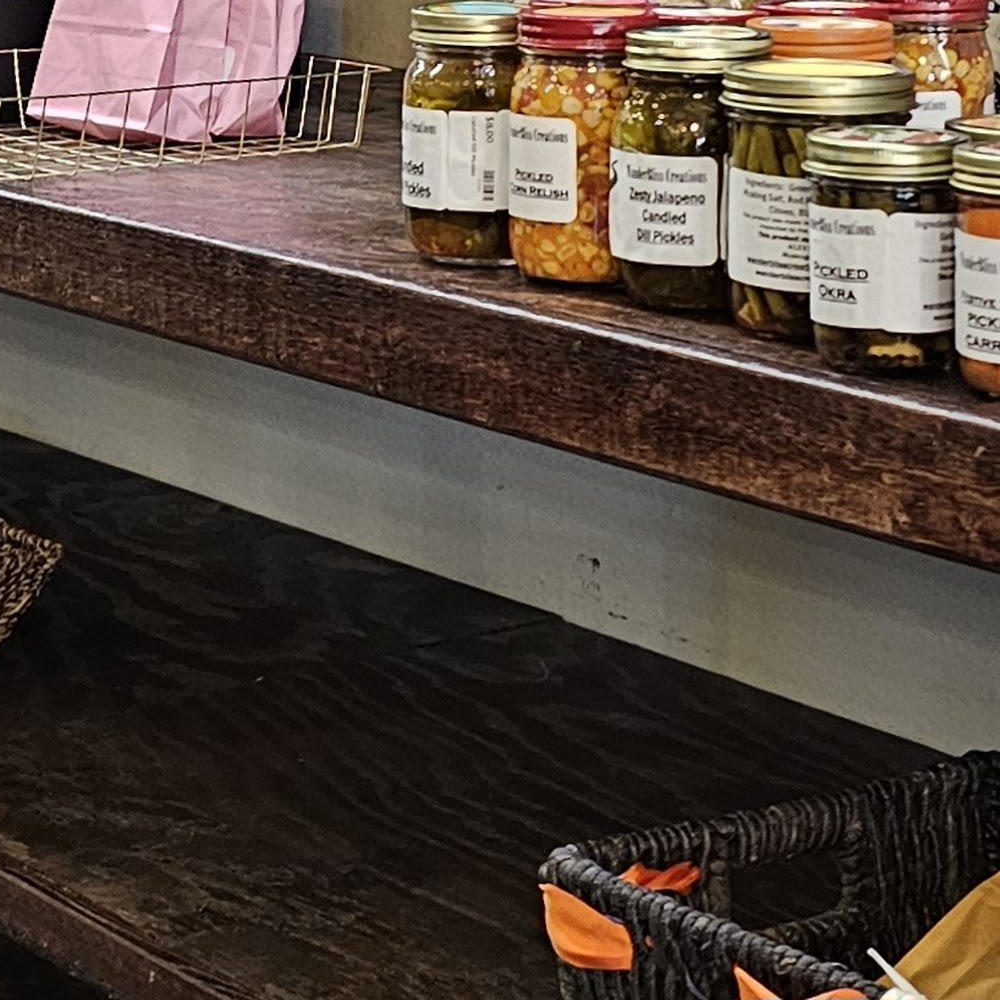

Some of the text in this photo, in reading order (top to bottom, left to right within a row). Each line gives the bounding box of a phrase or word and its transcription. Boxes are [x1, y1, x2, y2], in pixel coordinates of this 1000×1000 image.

[529, 186, 568, 200] RELISH
[630, 187, 706, 206] Zesty Jalapeno
[642, 209, 687, 225] Candied
[637, 228, 695, 246] Dill Pickles
[819, 283, 857, 301] OKRA
